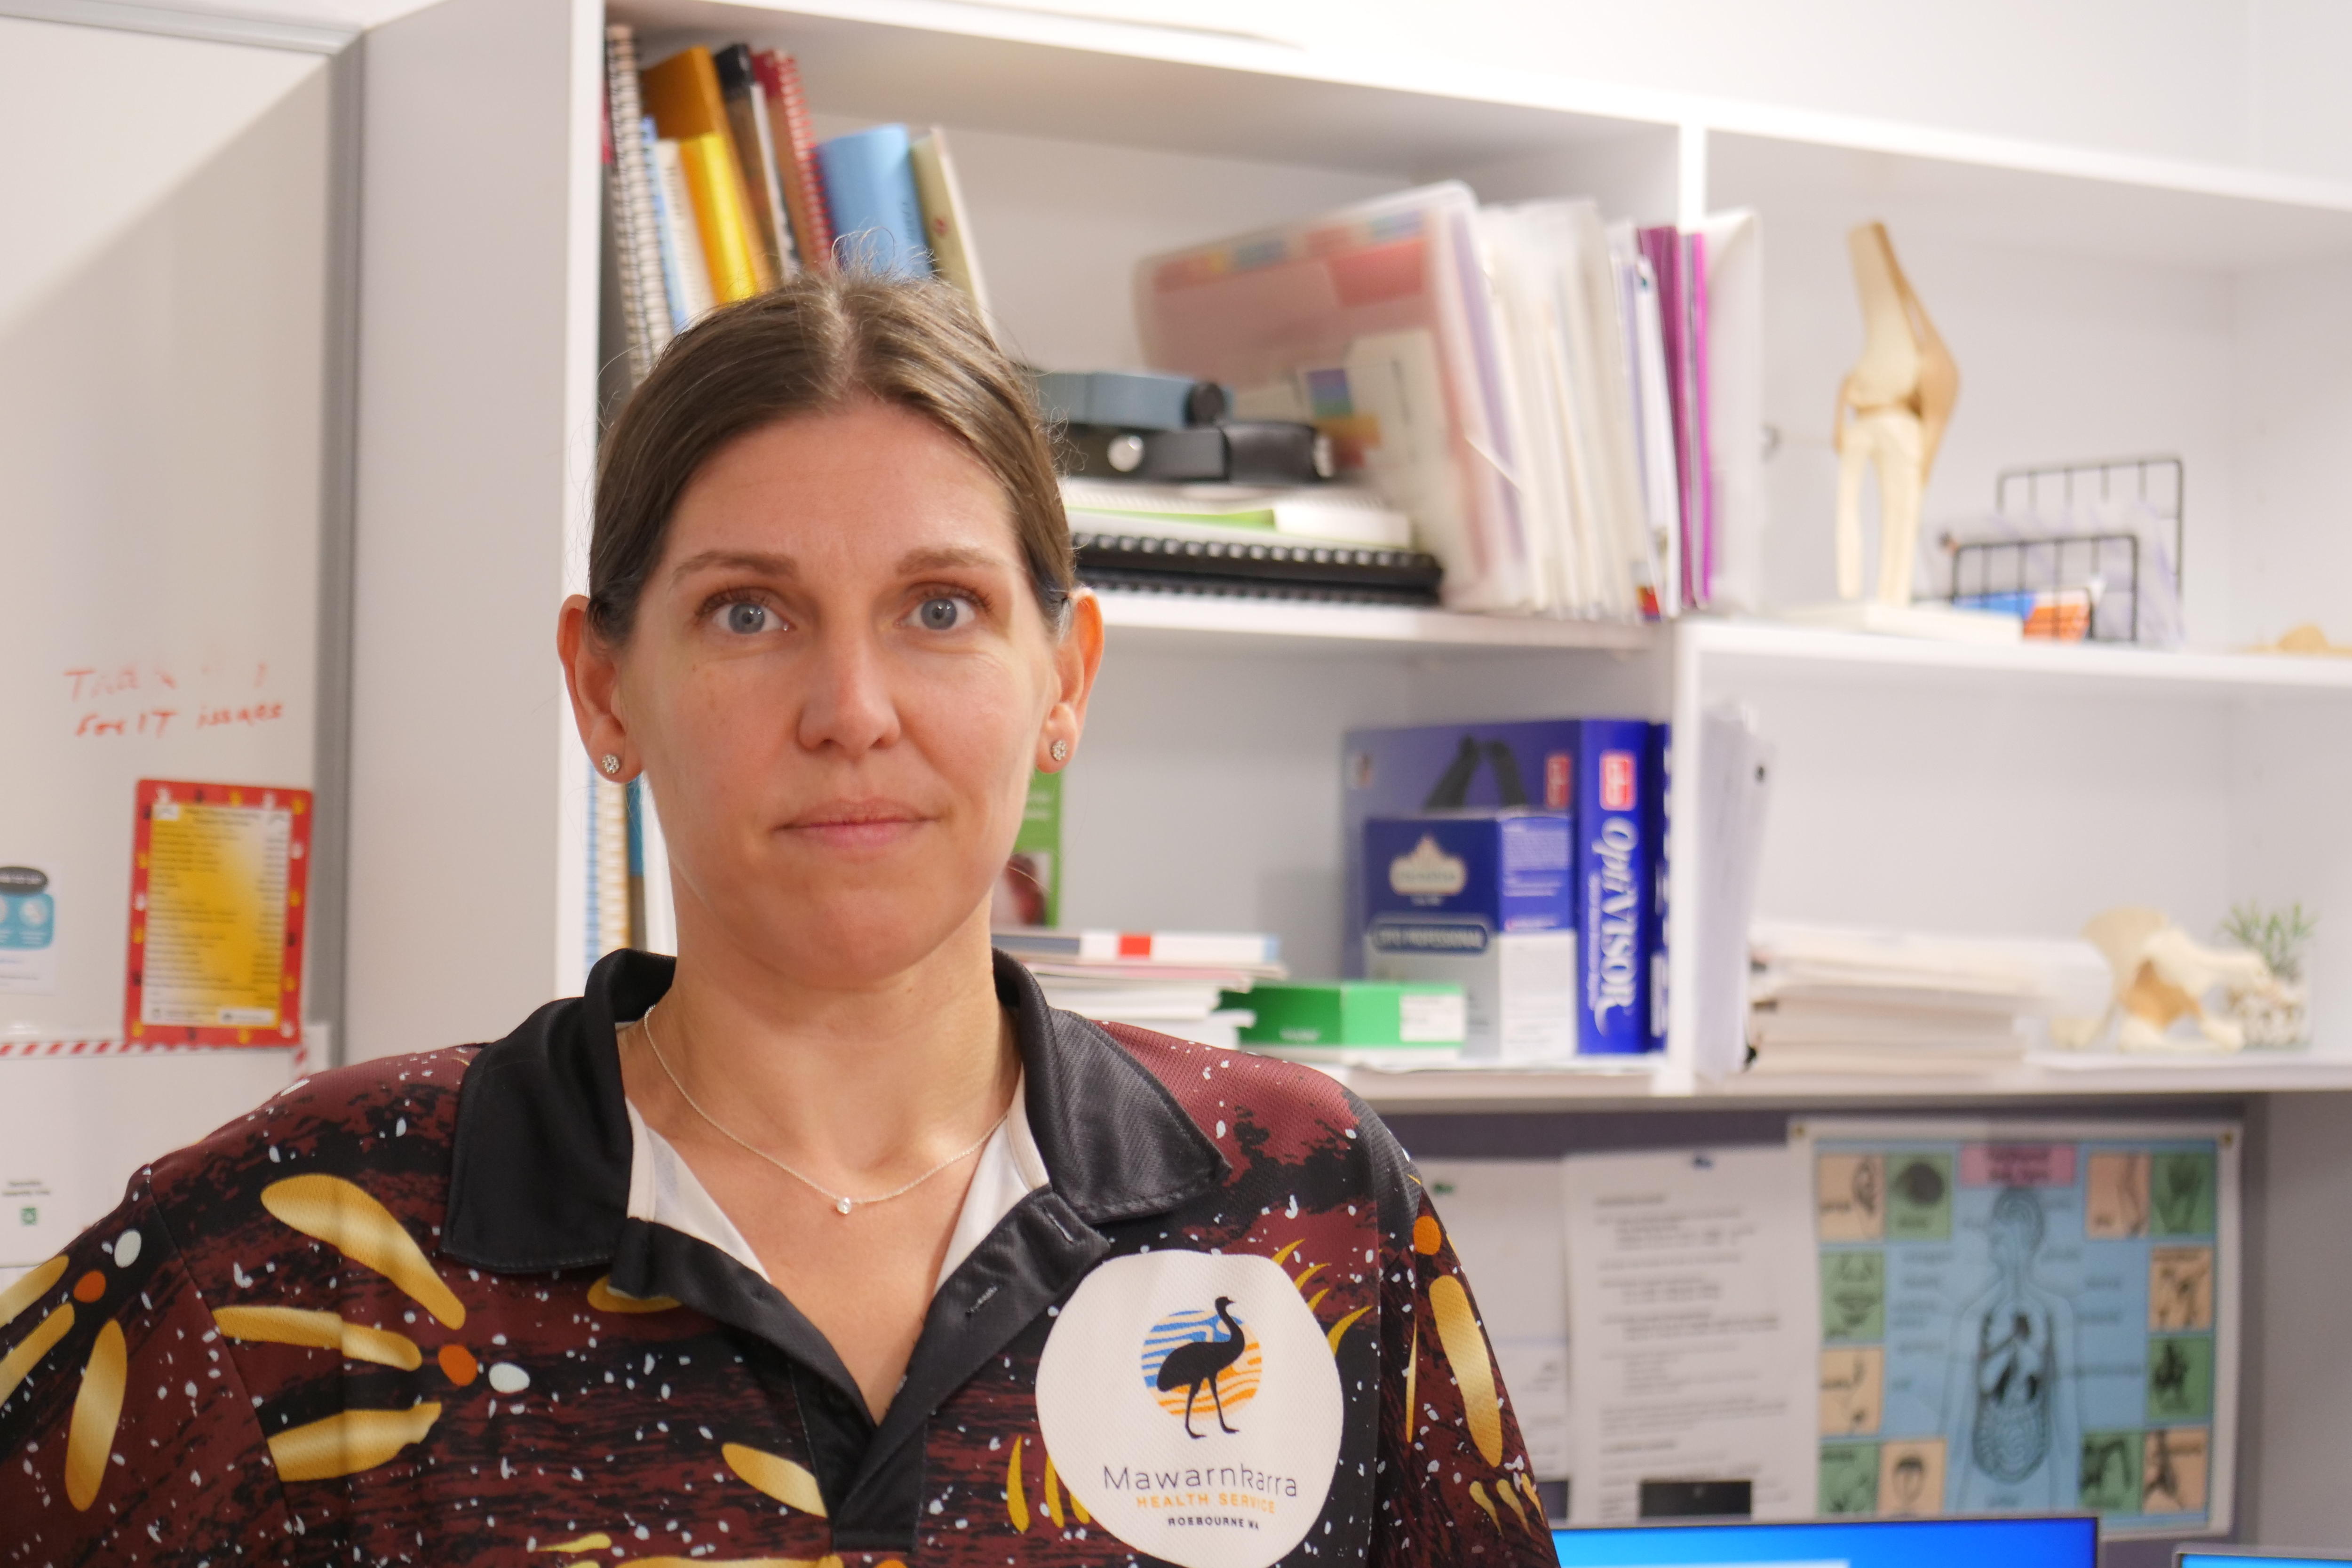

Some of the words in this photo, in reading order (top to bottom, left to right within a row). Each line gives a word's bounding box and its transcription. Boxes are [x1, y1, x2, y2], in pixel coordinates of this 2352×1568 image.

[137, 710, 178, 739] IT
[1104, 1464, 1297, 1497] Mawarnkarra
[1136, 1492, 1209, 1508] HEALTH
[1219, 1492, 1275, 1514] SERVICE
[1168, 1517, 1244, 1528] ROEBOURNE
